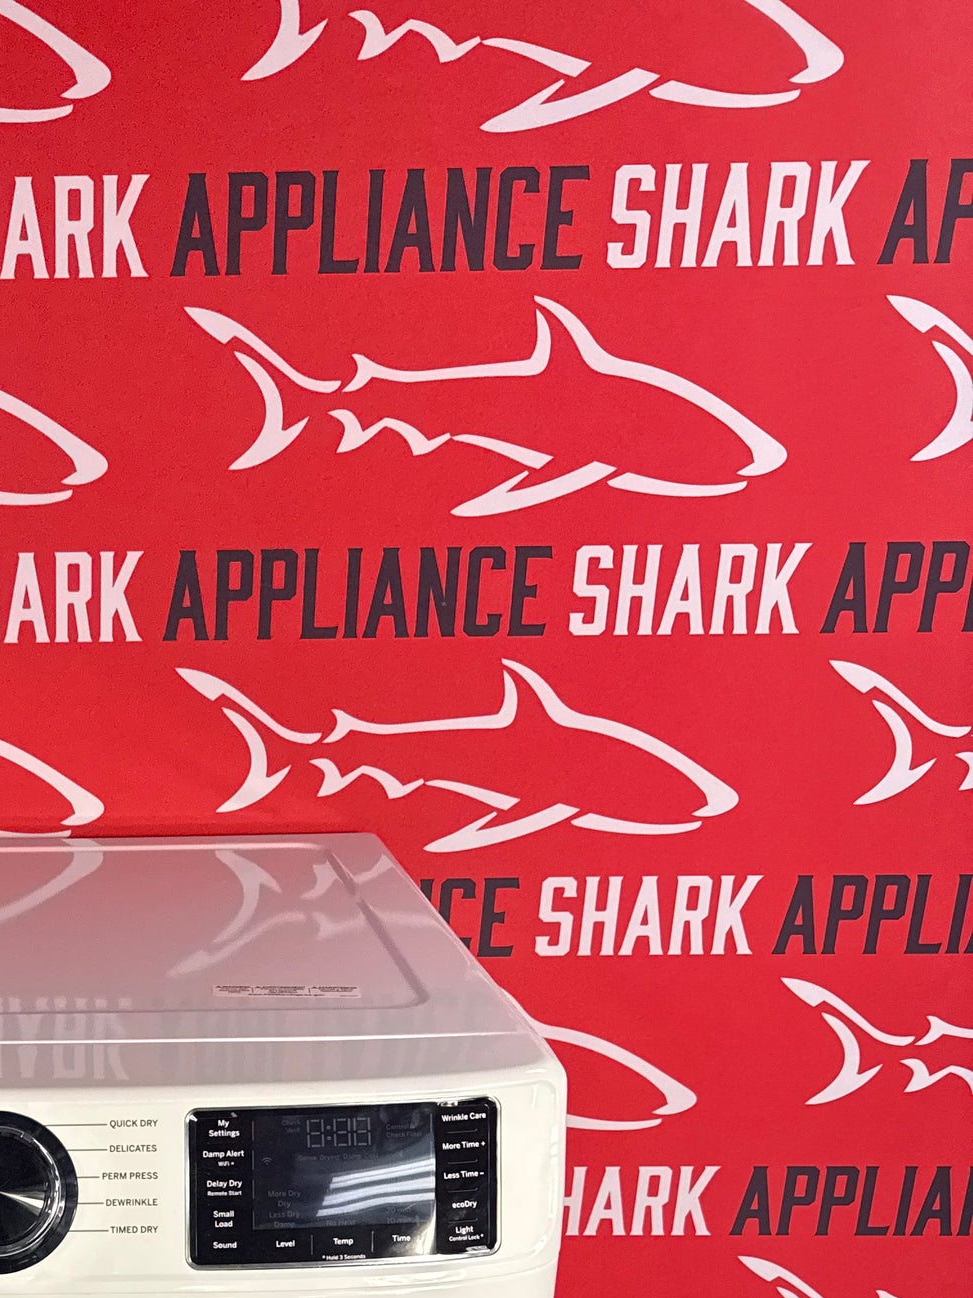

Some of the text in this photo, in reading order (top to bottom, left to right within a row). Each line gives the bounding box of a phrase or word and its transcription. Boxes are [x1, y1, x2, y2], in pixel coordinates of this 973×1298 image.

[170, 166, 591, 277] APPLIANCE
[607, 160, 871, 268] SHARK
[878, 158, 973, 265] AP
[162, 546, 554, 642] APPLIANCE
[568, 543, 813, 636] SHARK
[820, 542, 973, 633] APP
[535, 875, 764, 956] SHARK
[772, 875, 973, 955] APPLI
[441, 1112, 487, 1122] Wrinkle Care
[109, 1119, 159, 1129] QUICK DRY
[217, 1119, 230, 1128] My
[208, 1129, 240, 1138] Settings
[109, 1144, 158, 1153] DELICATES
[442, 1142, 461, 1150] More
[461, 1141, 480, 1149] Time
[202, 1149, 245, 1158] Damp Alert
[101, 1171, 159, 1181] PERM PRESS
[443, 1172, 460, 1180] Less
[461, 1170, 479, 1178] Time
[206, 1179, 243, 1188] Delay Dry
[105, 1198, 159, 1207] DEWRINKLE
[451, 1200, 477, 1208] ecoDry
[213, 1210, 235, 1218] Small
[214, 1220, 234, 1228] Load
[110, 1226, 159, 1235] TIMED DRY
[455, 1225, 474, 1234] Light
[333, 1237, 354, 1246] Temp
[392, 1234, 411, 1242] Time
[213, 1241, 238, 1249] Sound
[275, 1239, 295, 1248] Level
